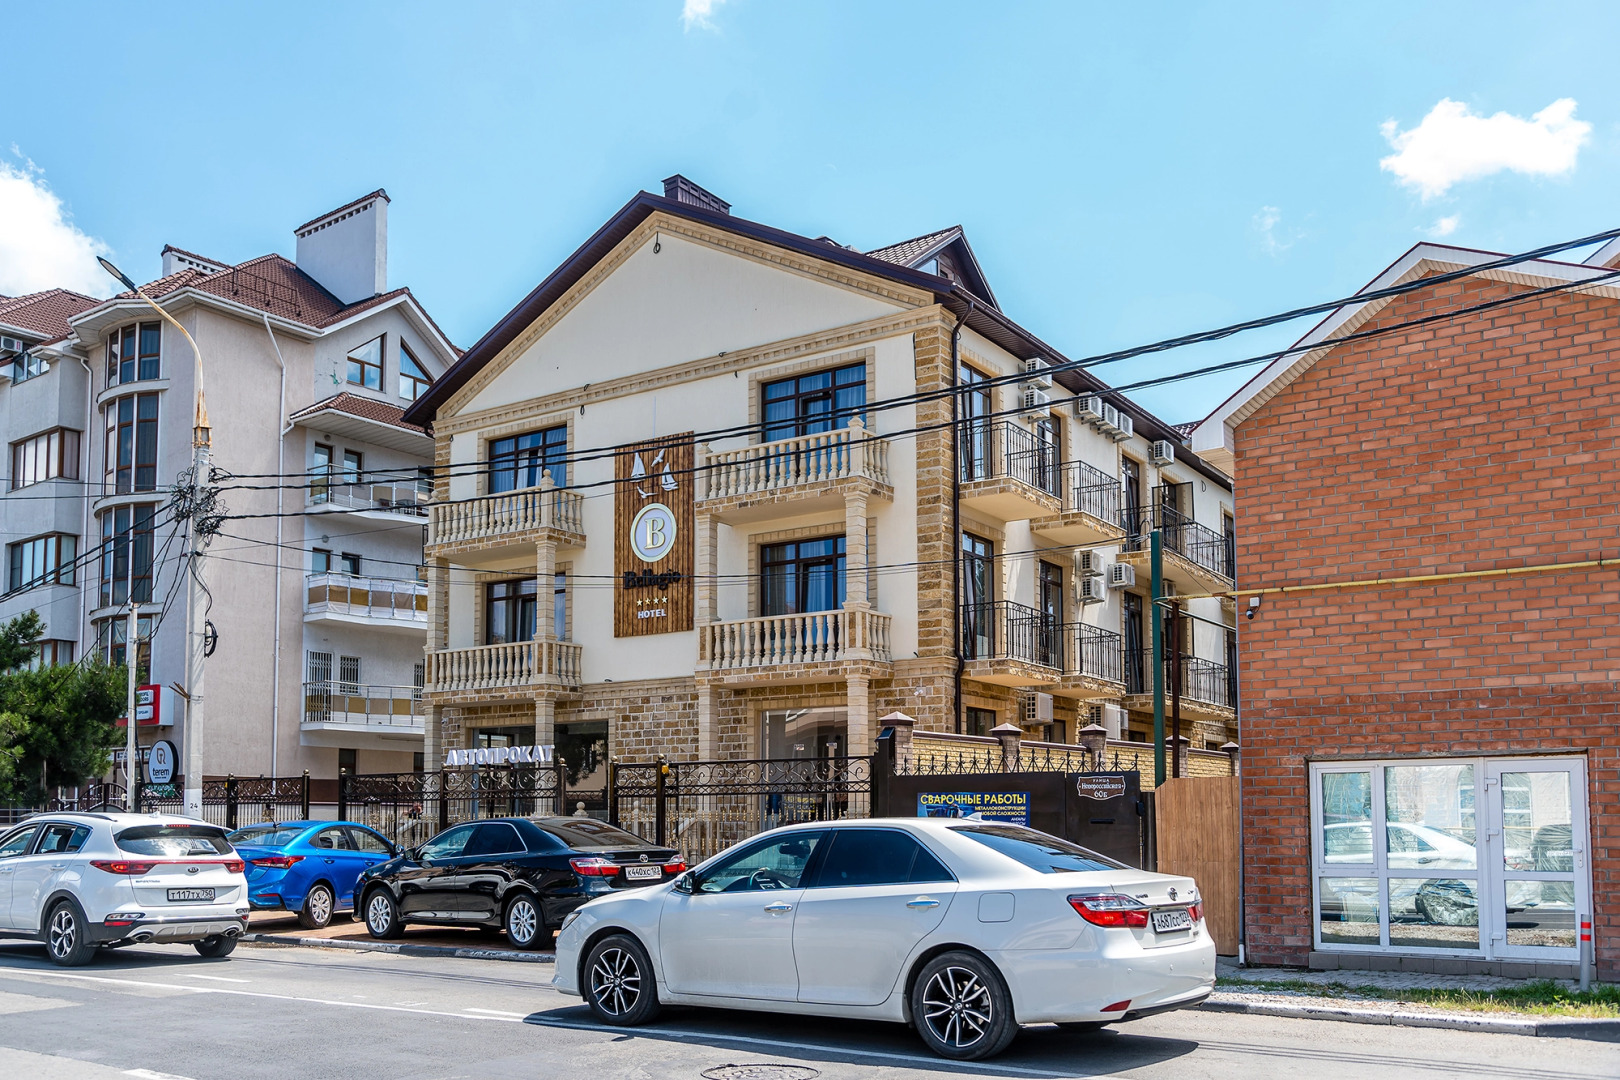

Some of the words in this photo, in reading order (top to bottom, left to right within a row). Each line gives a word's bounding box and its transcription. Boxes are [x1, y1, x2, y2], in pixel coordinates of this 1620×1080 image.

[644, 517, 666, 549] B
[623, 568, 681, 591] Bellagio
[637, 608, 667, 619] HOTEL
[446, 745, 555, 766] АВТОПРОКАТ
[152, 767, 169, 776] terem
[920, 794, 981, 805] СВАРОЧНЫЕ
[984, 793, 1026, 805] РАБОТЫ
